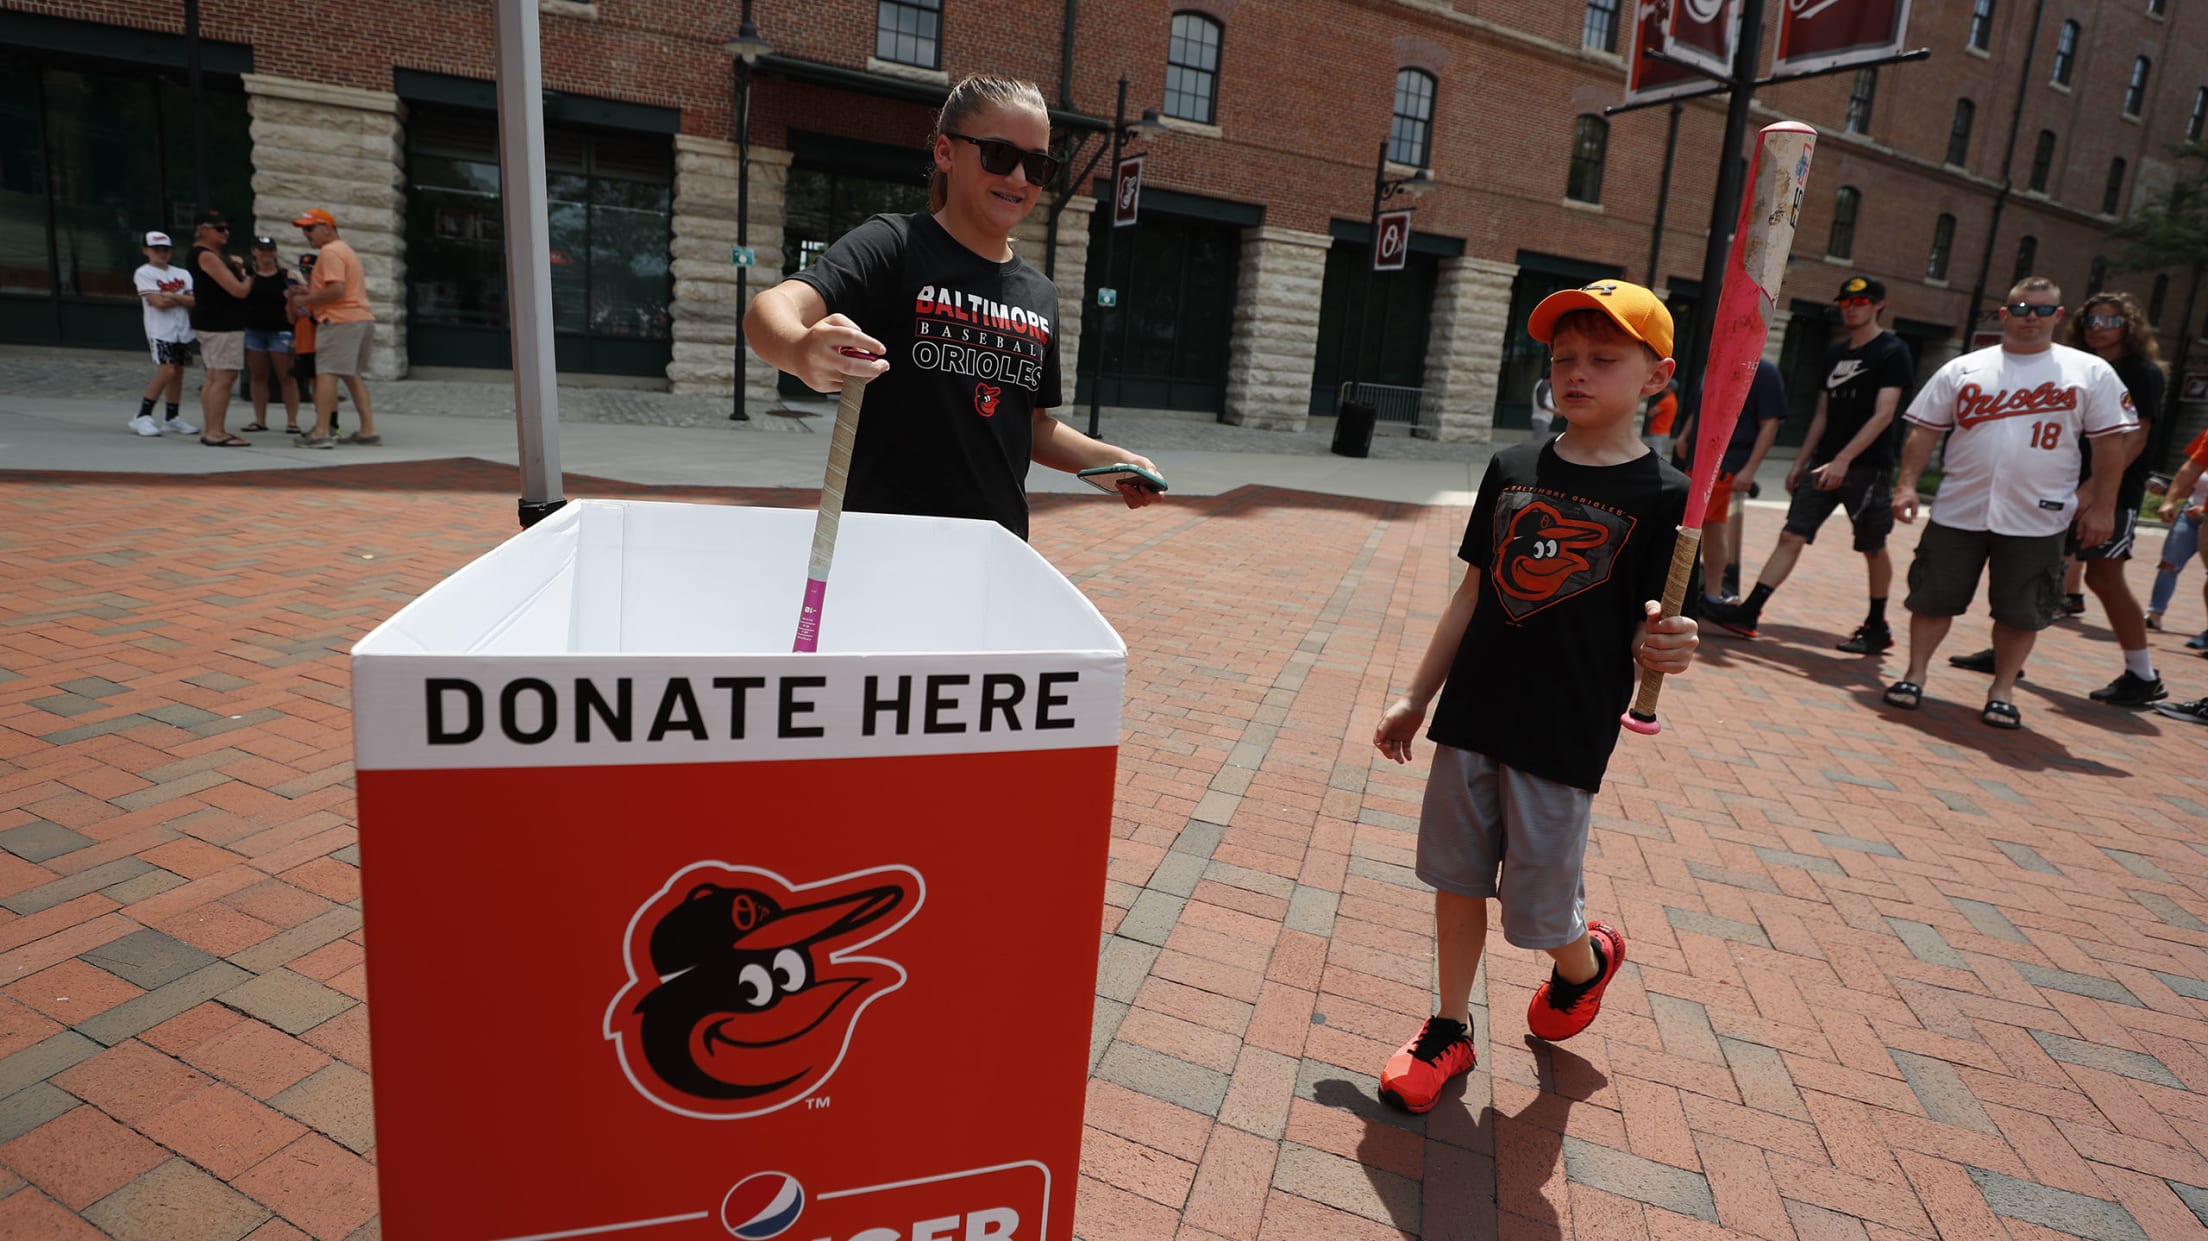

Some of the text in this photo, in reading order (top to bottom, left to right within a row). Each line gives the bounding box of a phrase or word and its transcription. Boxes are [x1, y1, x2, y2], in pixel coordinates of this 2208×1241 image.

[915, 285, 1050, 344] BALTIMORE
[912, 340, 1043, 392] ORIOLES
[1957, 381, 2078, 422] Orioles
[2031, 420, 2063, 450] 18
[1511, 484, 1624, 517] BALTIMORE ORIOLES
[425, 672, 1079, 746] DONATE HERE
[806, 1096, 831, 1110] TM
